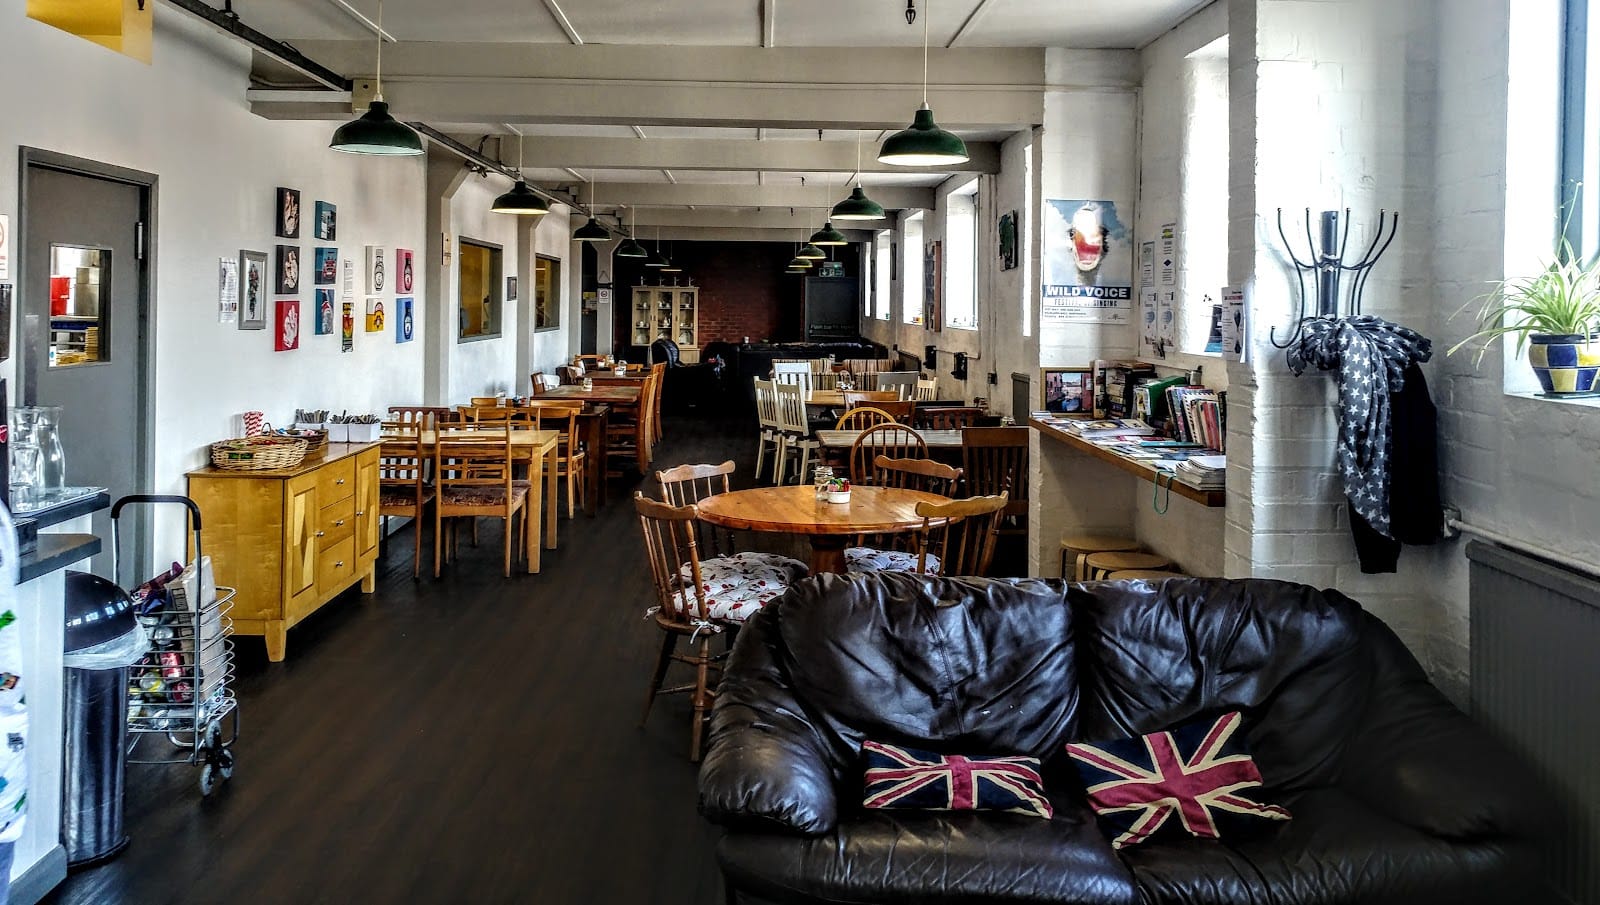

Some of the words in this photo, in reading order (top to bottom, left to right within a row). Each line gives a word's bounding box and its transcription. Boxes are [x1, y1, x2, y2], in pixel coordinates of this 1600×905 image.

[1047, 286, 1081, 297] WILD
[1085, 287, 1128, 298] VOICE
[1054, 298, 1081, 306] FESTIV
